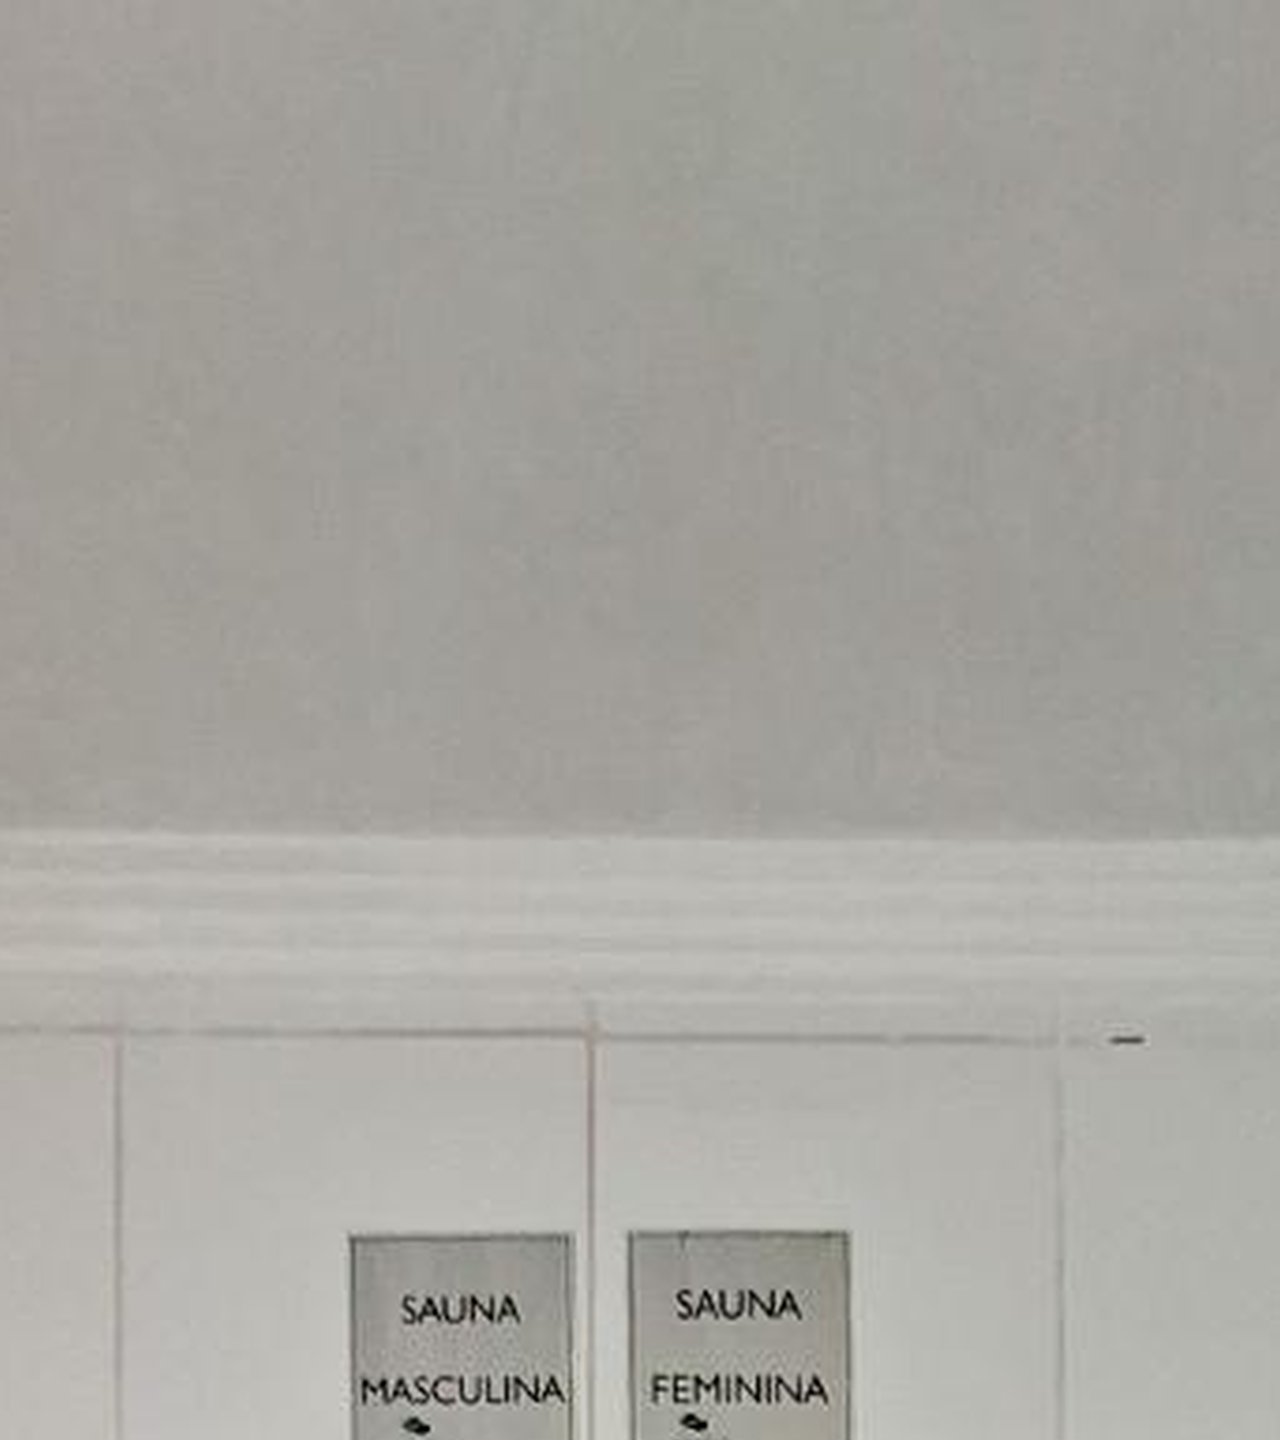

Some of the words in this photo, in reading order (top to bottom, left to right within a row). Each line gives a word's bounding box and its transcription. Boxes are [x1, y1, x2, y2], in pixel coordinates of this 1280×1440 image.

[401, 1294, 521, 1325] SAUNA
[675, 1288, 803, 1320] SAUNA
[360, 1374, 566, 1405] MASCULINA
[651, 1373, 829, 1404] FEMININA
